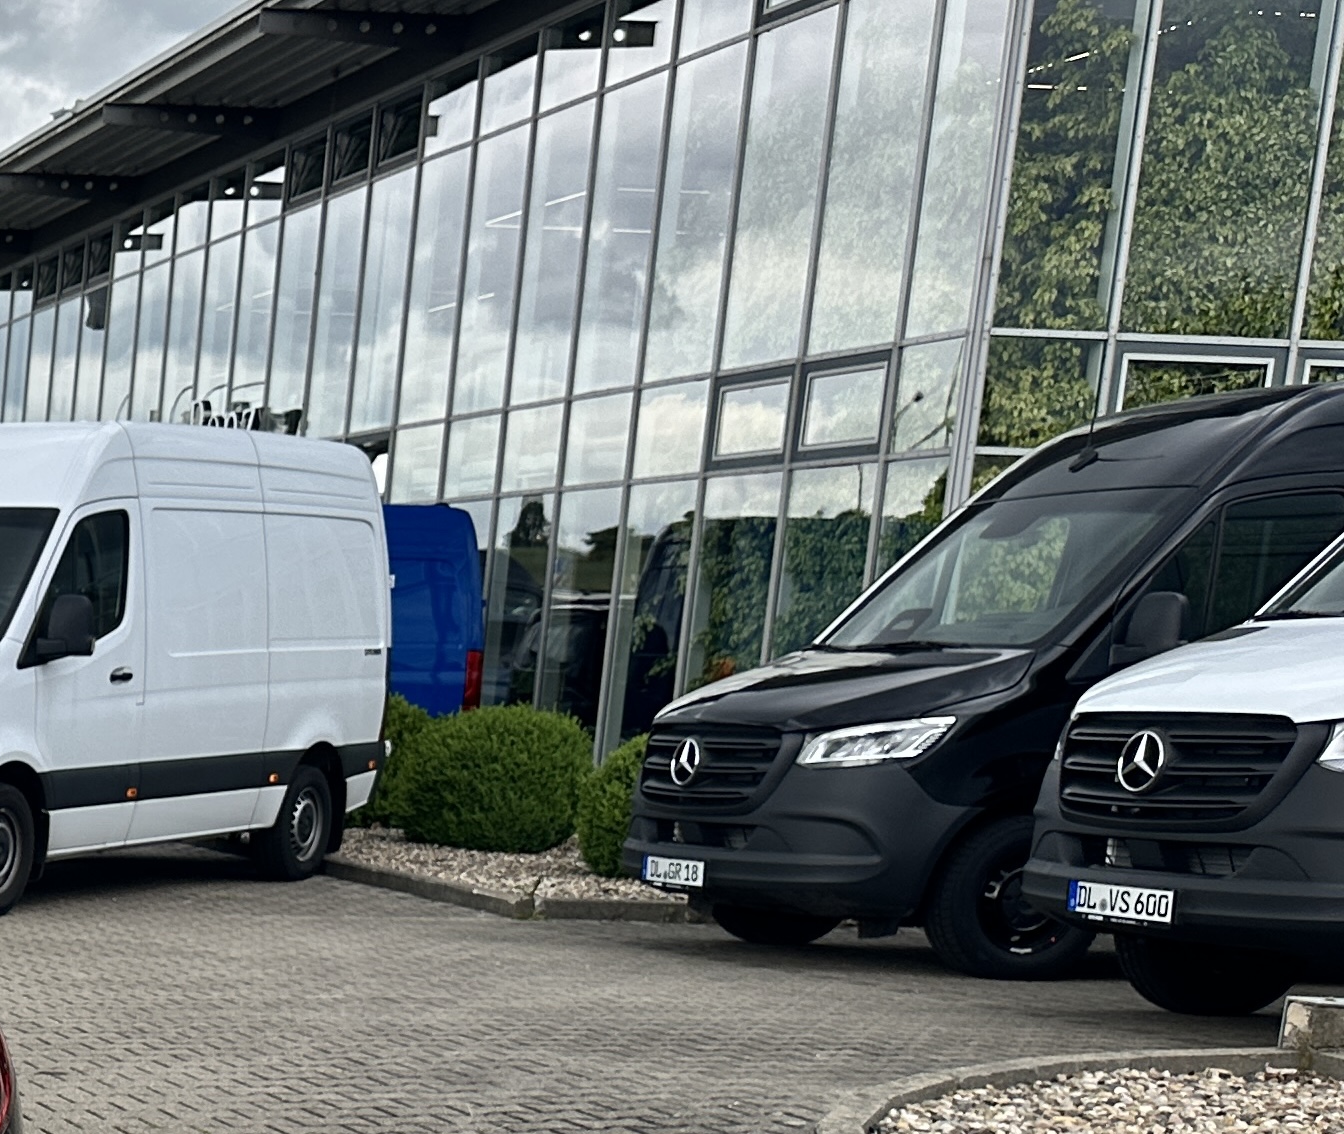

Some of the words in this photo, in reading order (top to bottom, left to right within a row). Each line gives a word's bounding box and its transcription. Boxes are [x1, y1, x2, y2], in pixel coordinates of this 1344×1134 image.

[683, 863, 699, 882] 18
[1077, 885, 1097, 910] DL
[1109, 888, 1131, 913] VS
[1134, 892, 1169, 918] 600
